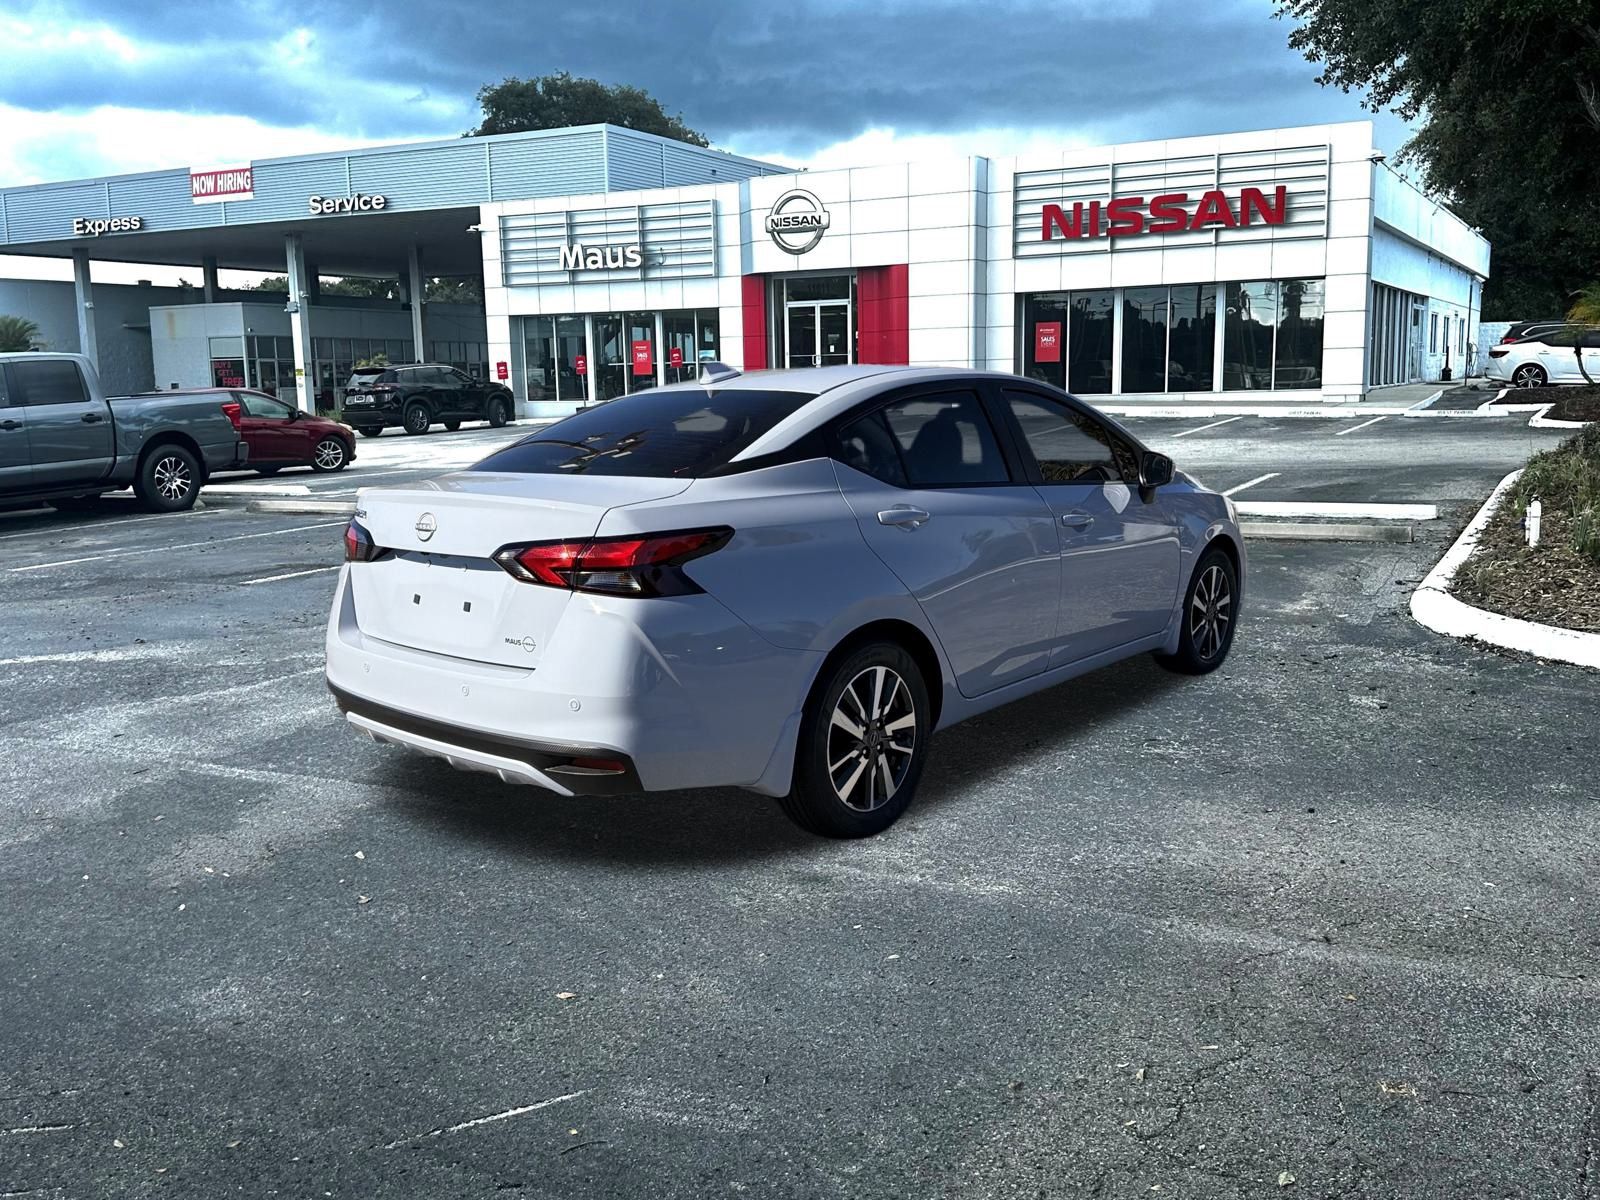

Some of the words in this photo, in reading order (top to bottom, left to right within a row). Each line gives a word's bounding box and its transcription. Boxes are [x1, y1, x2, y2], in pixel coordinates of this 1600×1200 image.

[192, 174, 215, 195] NOW
[217, 171, 251, 192] HIRING
[309, 193, 385, 215] Service
[1042, 185, 1287, 241] NISSAN
[73, 216, 141, 237] Express
[771, 215, 821, 228] NISSAN
[560, 243, 642, 270] Maus
[222, 377, 244, 387] FREE
[505, 637, 521, 646] MAUS
